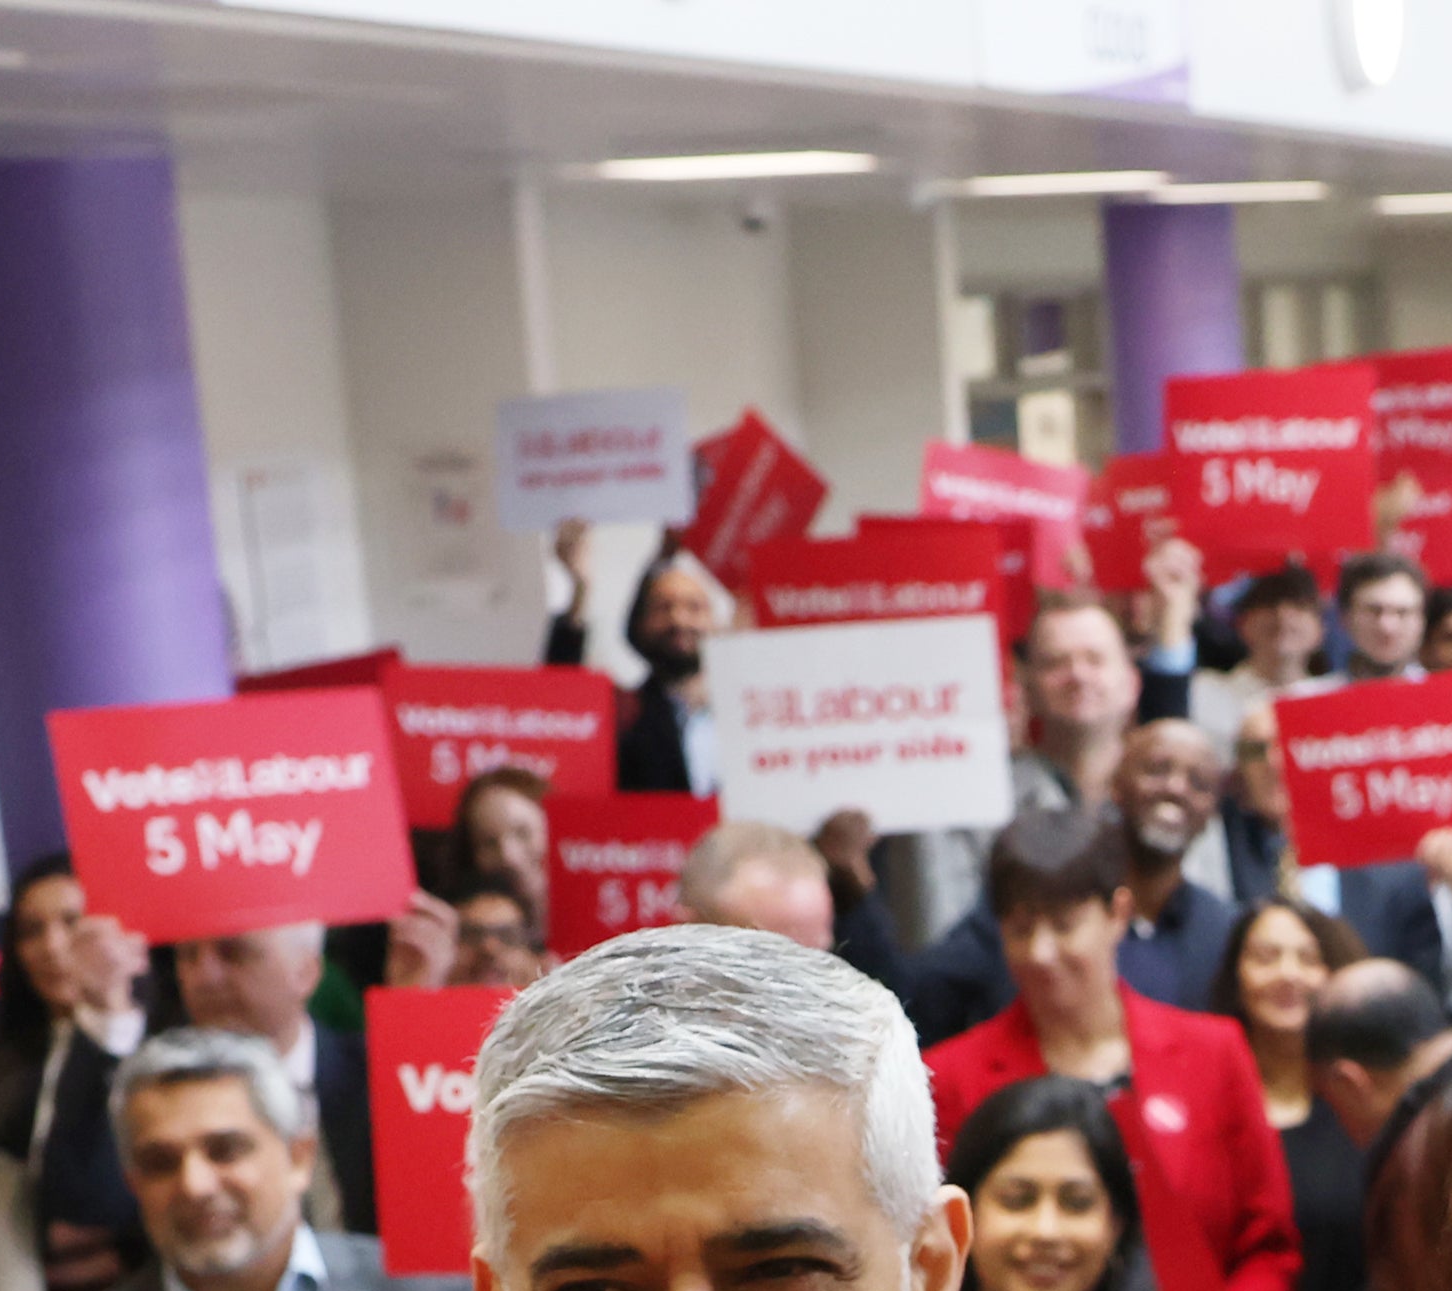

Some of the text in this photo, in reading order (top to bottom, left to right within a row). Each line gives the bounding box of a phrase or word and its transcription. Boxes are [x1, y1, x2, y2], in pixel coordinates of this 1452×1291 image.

[82, 752, 374, 813] Vote Labour
[1331, 771, 1363, 821] 5
[144, 808, 325, 877] 5 May
[398, 1062, 479, 1115] Vo
